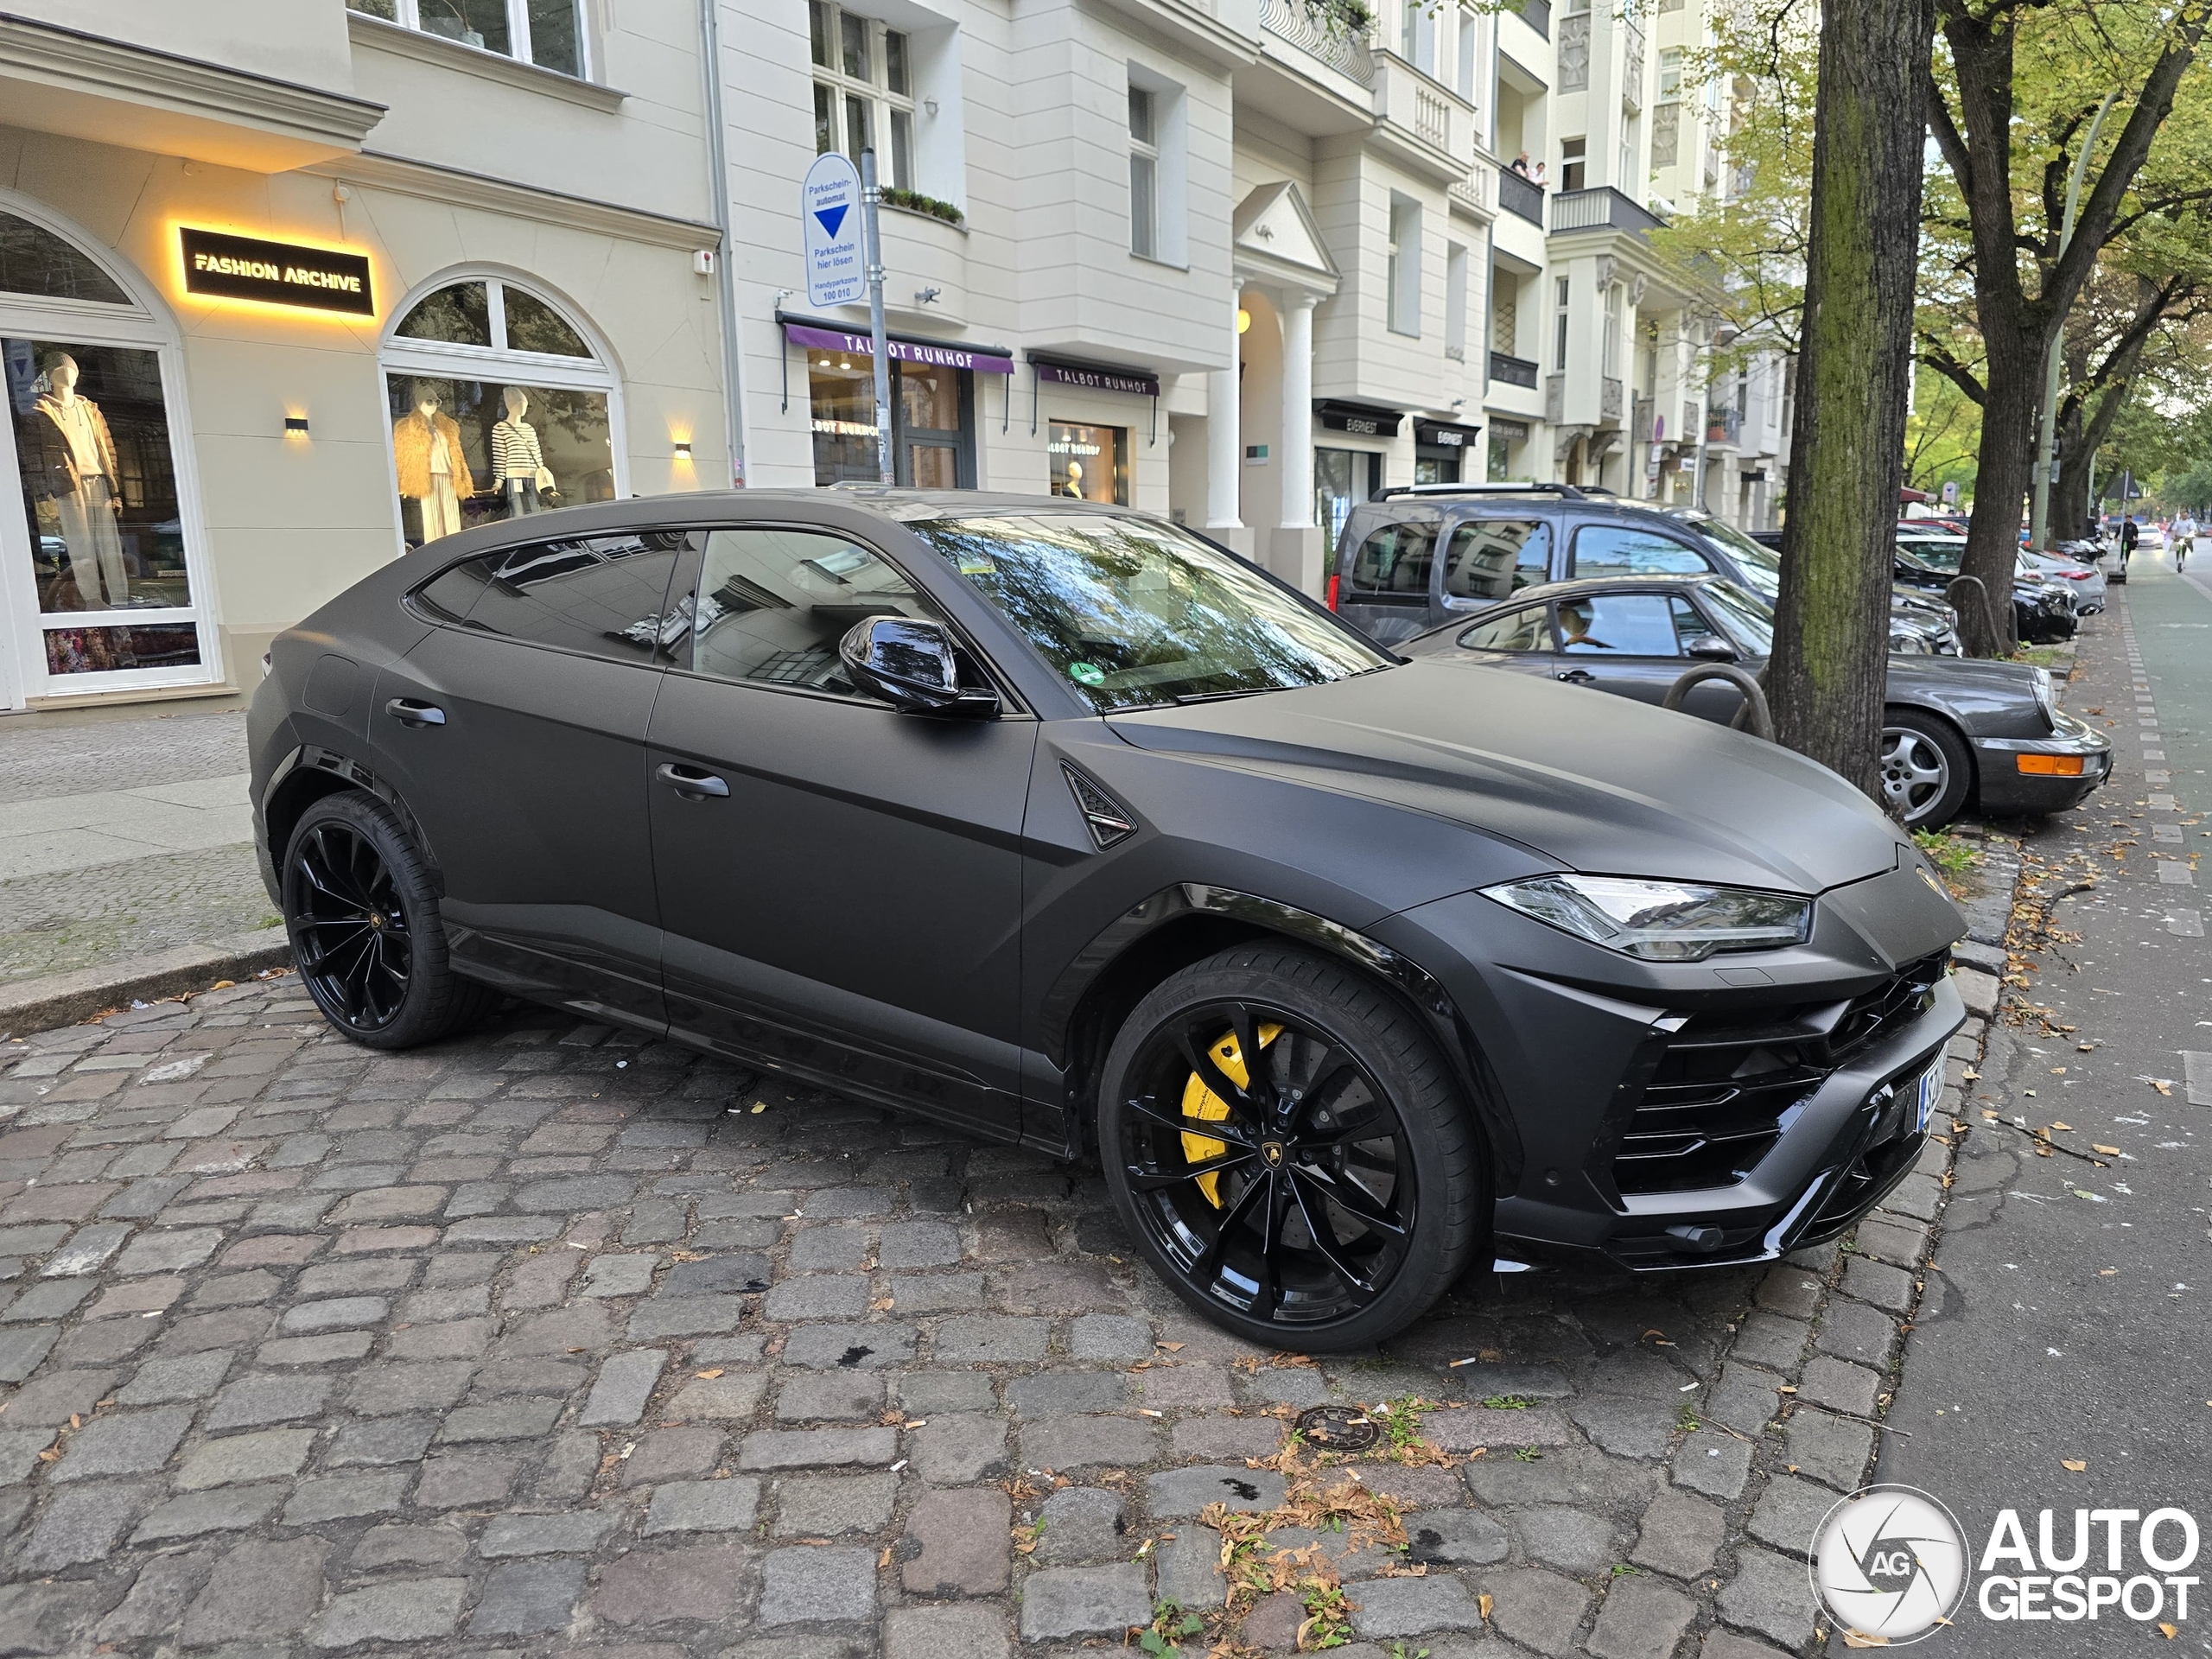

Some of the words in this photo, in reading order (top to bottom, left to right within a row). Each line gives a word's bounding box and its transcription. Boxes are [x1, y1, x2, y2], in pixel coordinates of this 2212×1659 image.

[809, 179, 851, 195] Parkschein-
[816, 192, 846, 207] automat
[814, 243, 855, 257] Parkschein
[817, 258, 831, 270] hier
[833, 256, 853, 267] lösen
[195, 254, 279, 281] FASHION
[284, 267, 361, 292] ARCHIVE
[815, 276, 858, 290] Handyparkzone
[823, 290, 836, 301] 100
[837, 288, 850, 299] 010
[844, 335, 906, 359] TALOT
[914, 347, 973, 368] RUNHOF
[1056, 369, 1100, 387] TALBOT
[1105, 377, 1147, 393] RUNHOF
[810, 420, 836, 433] LBOT
[1346, 418, 1377, 435] EVERNEST
[1077, 664, 1090, 673] 4
[1193, 1087, 1209, 1120] mborghini
